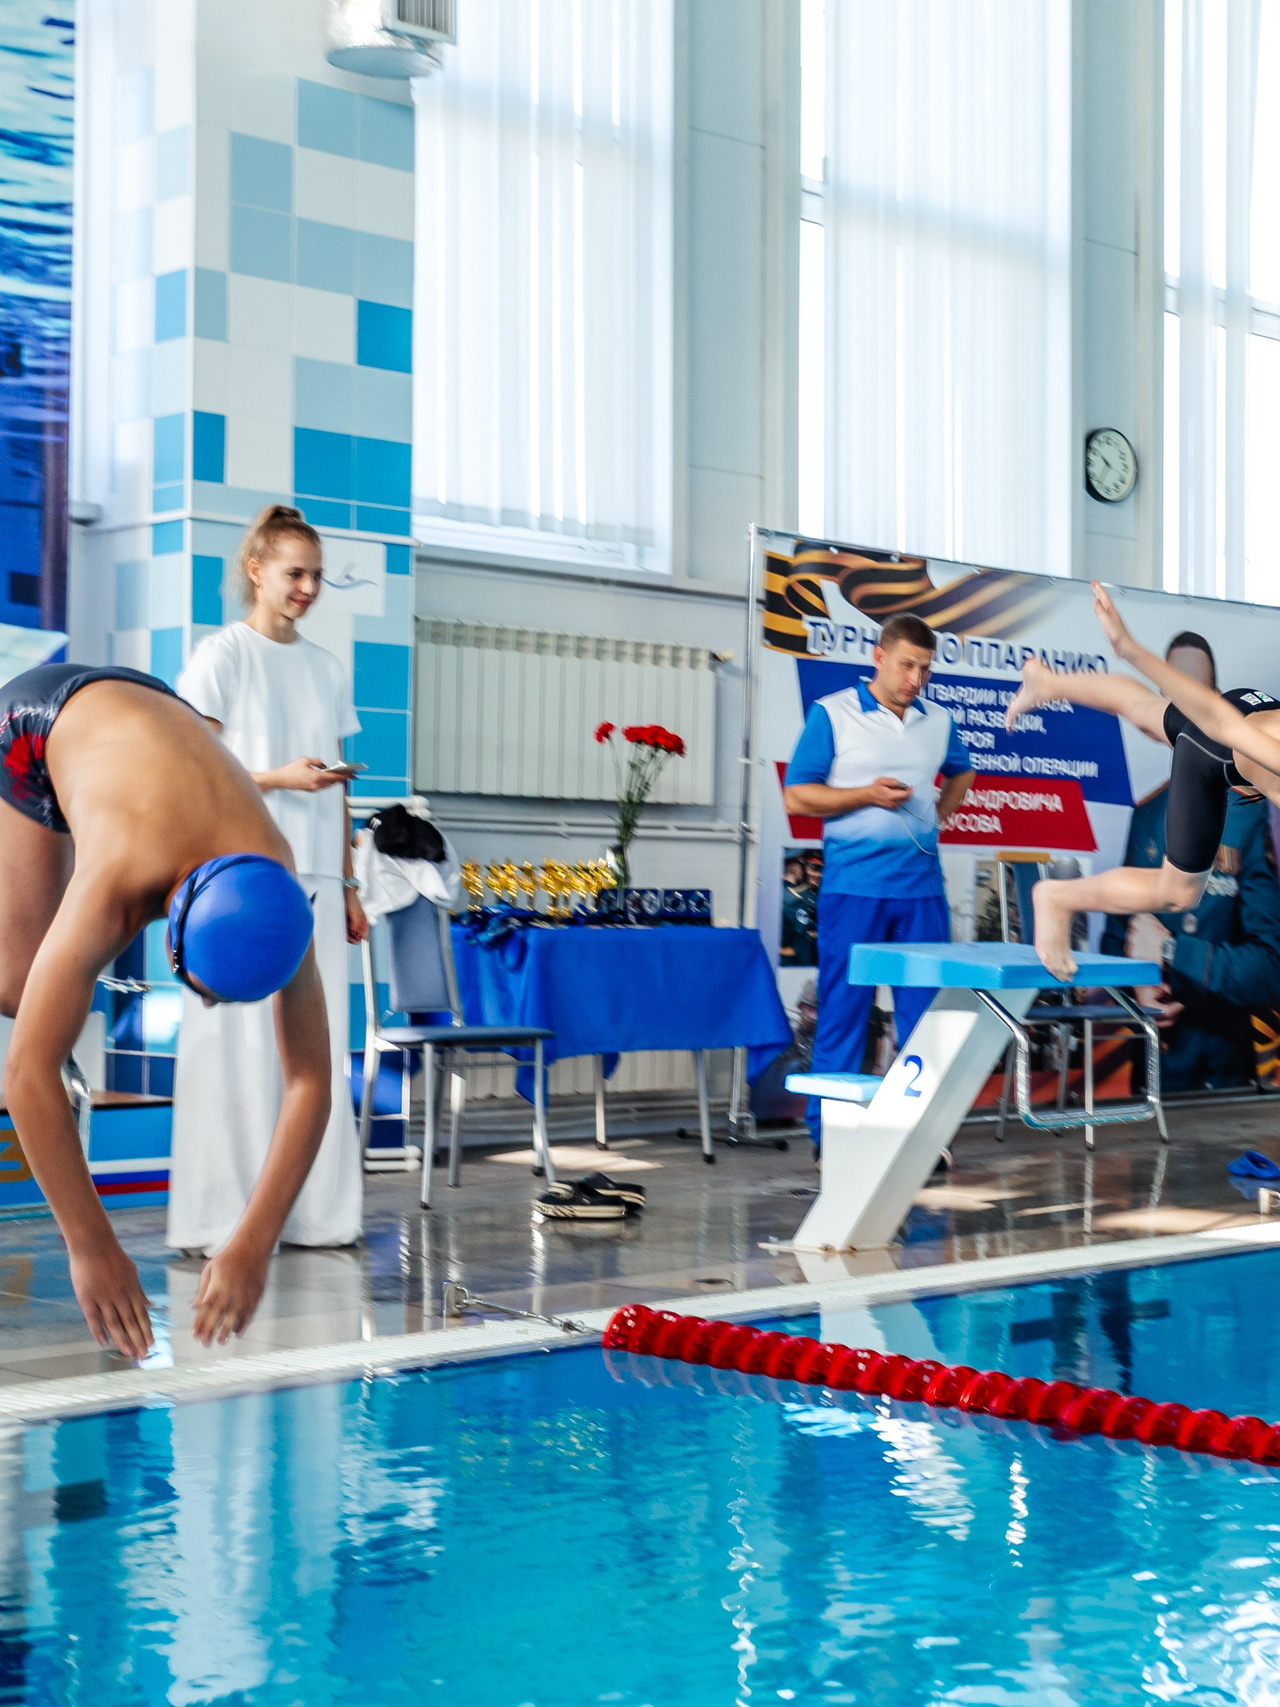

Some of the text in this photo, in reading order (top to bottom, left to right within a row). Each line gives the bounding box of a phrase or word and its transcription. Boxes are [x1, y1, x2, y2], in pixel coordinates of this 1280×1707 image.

[804, 618, 881, 656] ТУРН
[928, 683, 997, 707] ГВАРДИИ
[967, 709, 1048, 735] РАЗВДКИ,
[1022, 756, 1099, 779] ОПЕРАЦИИ
[903, 1054, 923, 1098] 2
